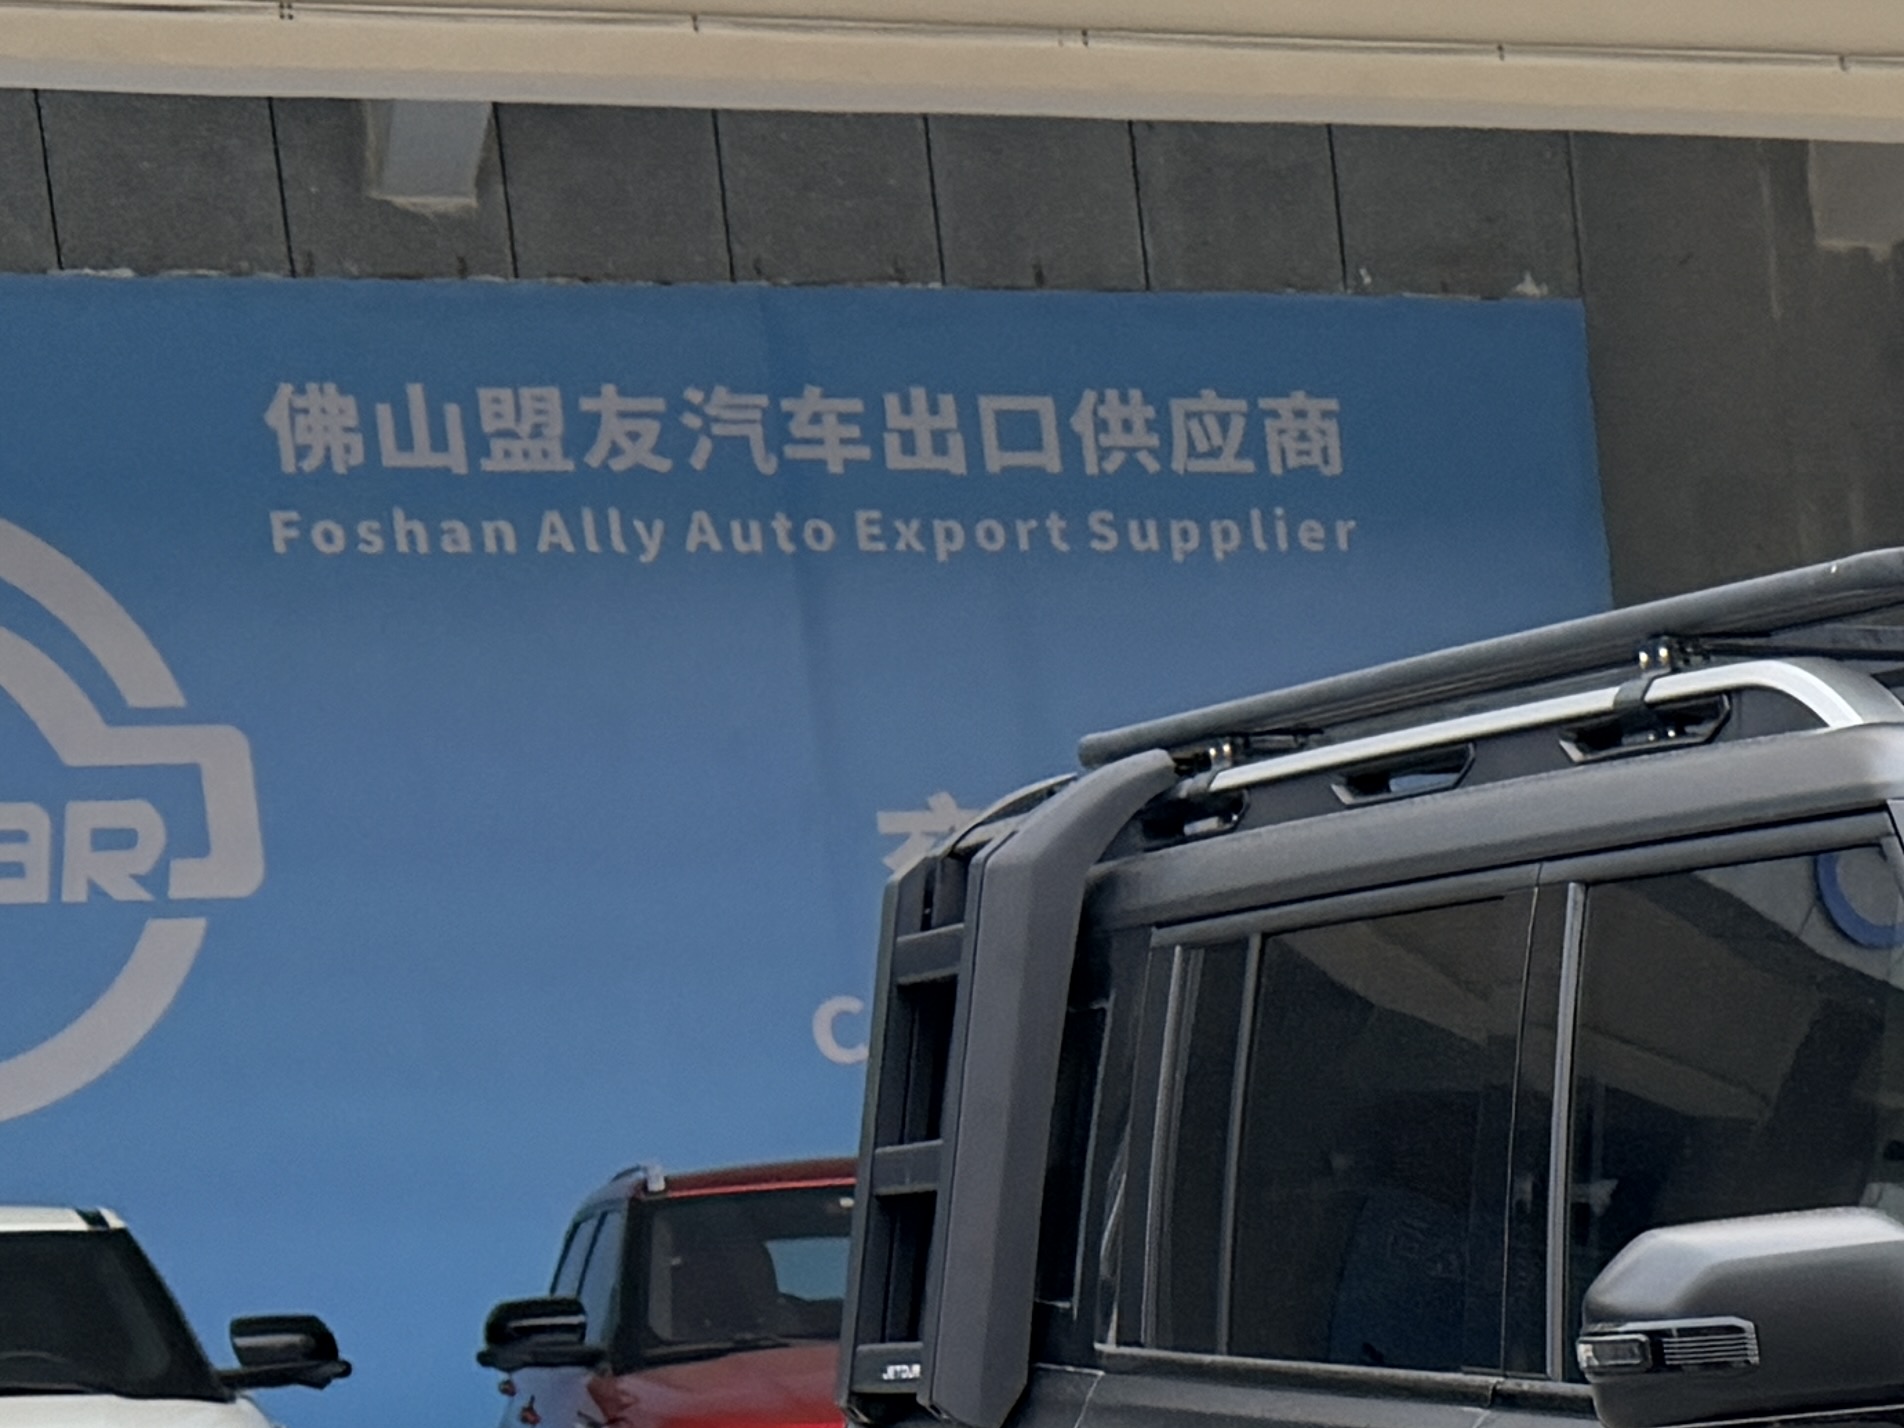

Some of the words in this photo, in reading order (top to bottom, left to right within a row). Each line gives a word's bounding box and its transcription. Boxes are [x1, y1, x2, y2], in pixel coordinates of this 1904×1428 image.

[263, 382, 1346, 477] 佛山盟友汽车出口供应商
[270, 508, 517, 556] Foshan
[537, 506, 666, 564] Ally
[685, 509, 838, 555] Auto
[855, 508, 1071, 563] Export
[1089, 507, 1358, 563] Supplier
